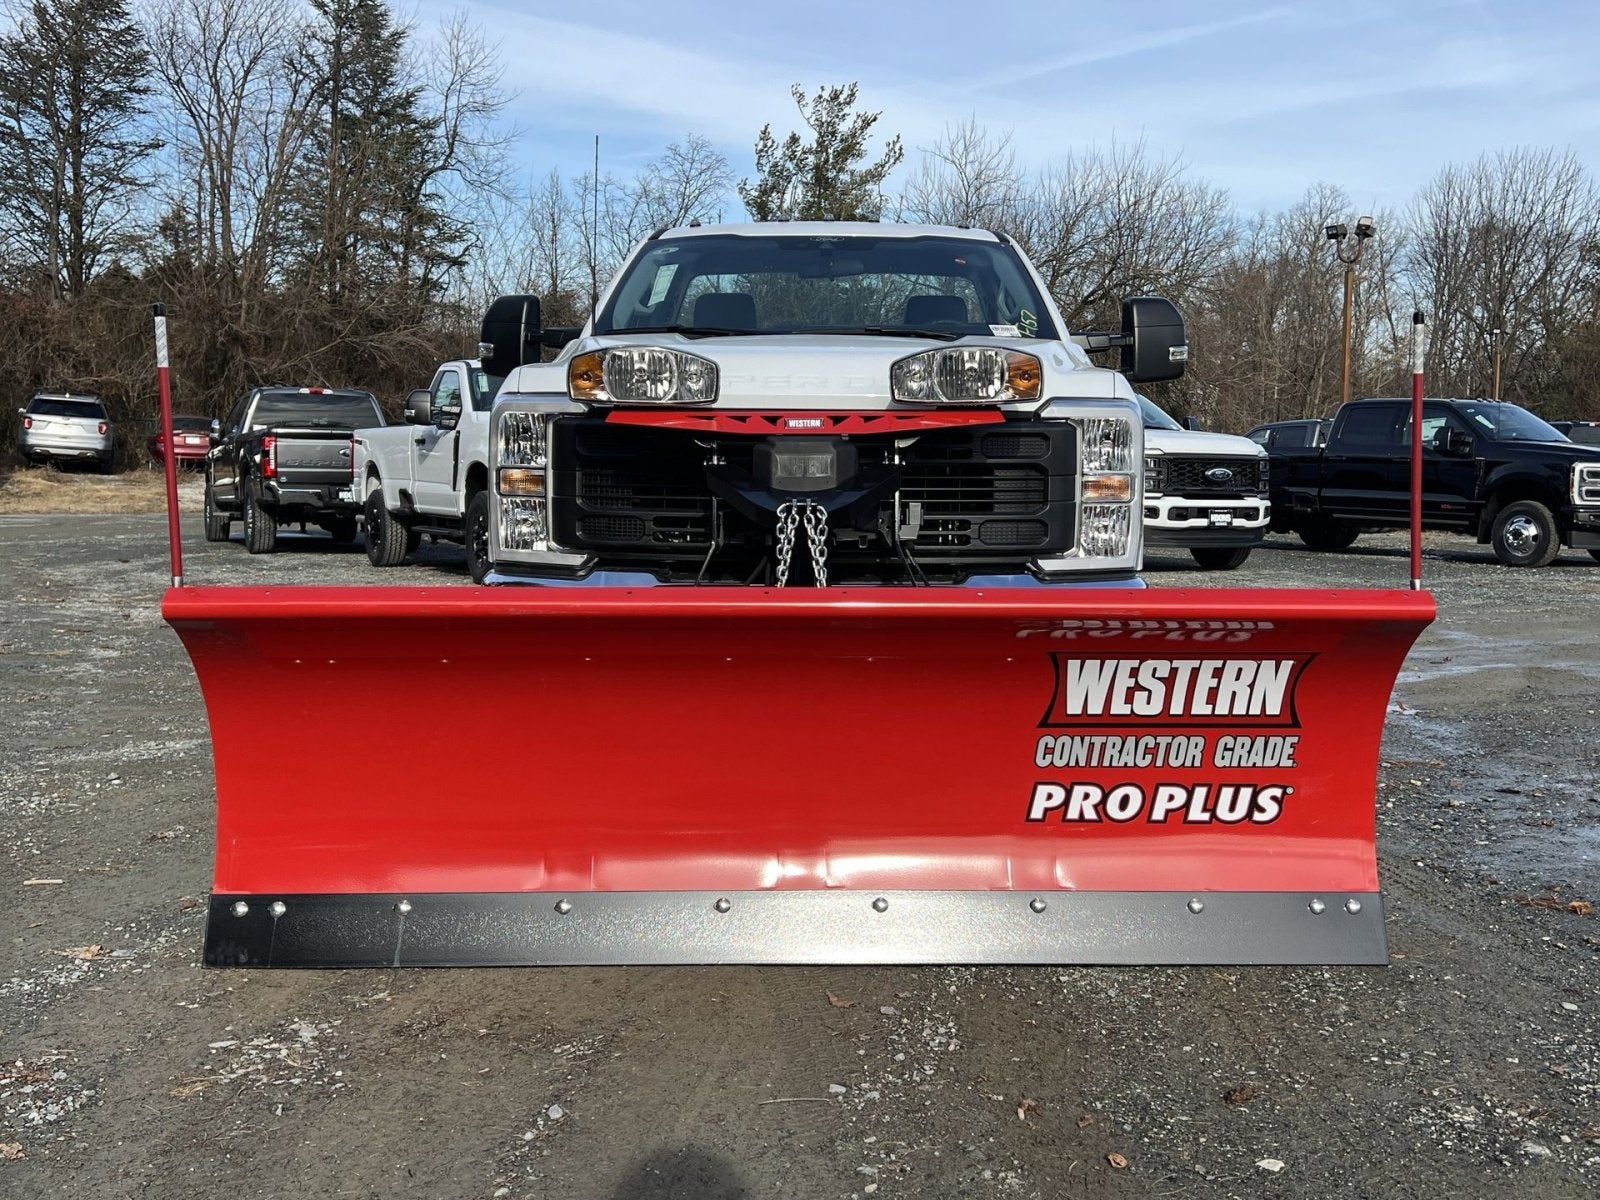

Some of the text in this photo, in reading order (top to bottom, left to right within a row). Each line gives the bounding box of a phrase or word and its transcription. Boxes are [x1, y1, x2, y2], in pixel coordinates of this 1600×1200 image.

[788, 419, 821, 428] WESTERN
[1065, 658, 1296, 716] WESTERN
[1035, 735, 1299, 768] CONTRACTOR GRADE
[1026, 782, 1145, 823] PRO
